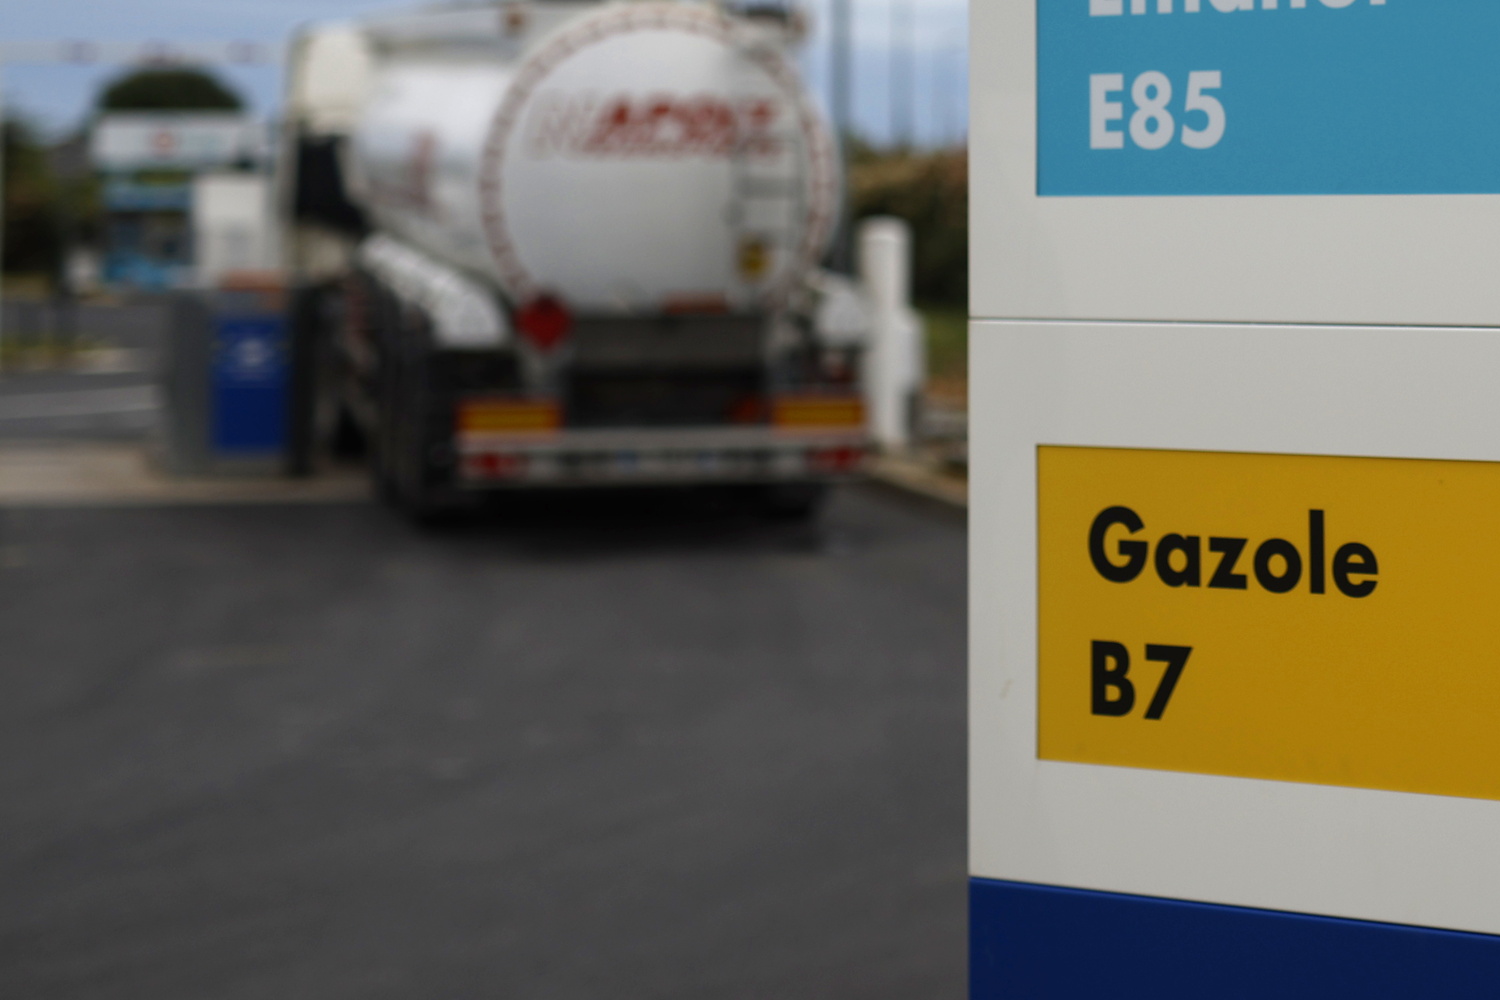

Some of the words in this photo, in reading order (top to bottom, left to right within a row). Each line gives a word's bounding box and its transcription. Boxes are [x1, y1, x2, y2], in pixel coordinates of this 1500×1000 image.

[1090, 70, 1225, 149] E85
[1087, 505, 1379, 599] Gazole
[1090, 639, 1194, 721] B7
